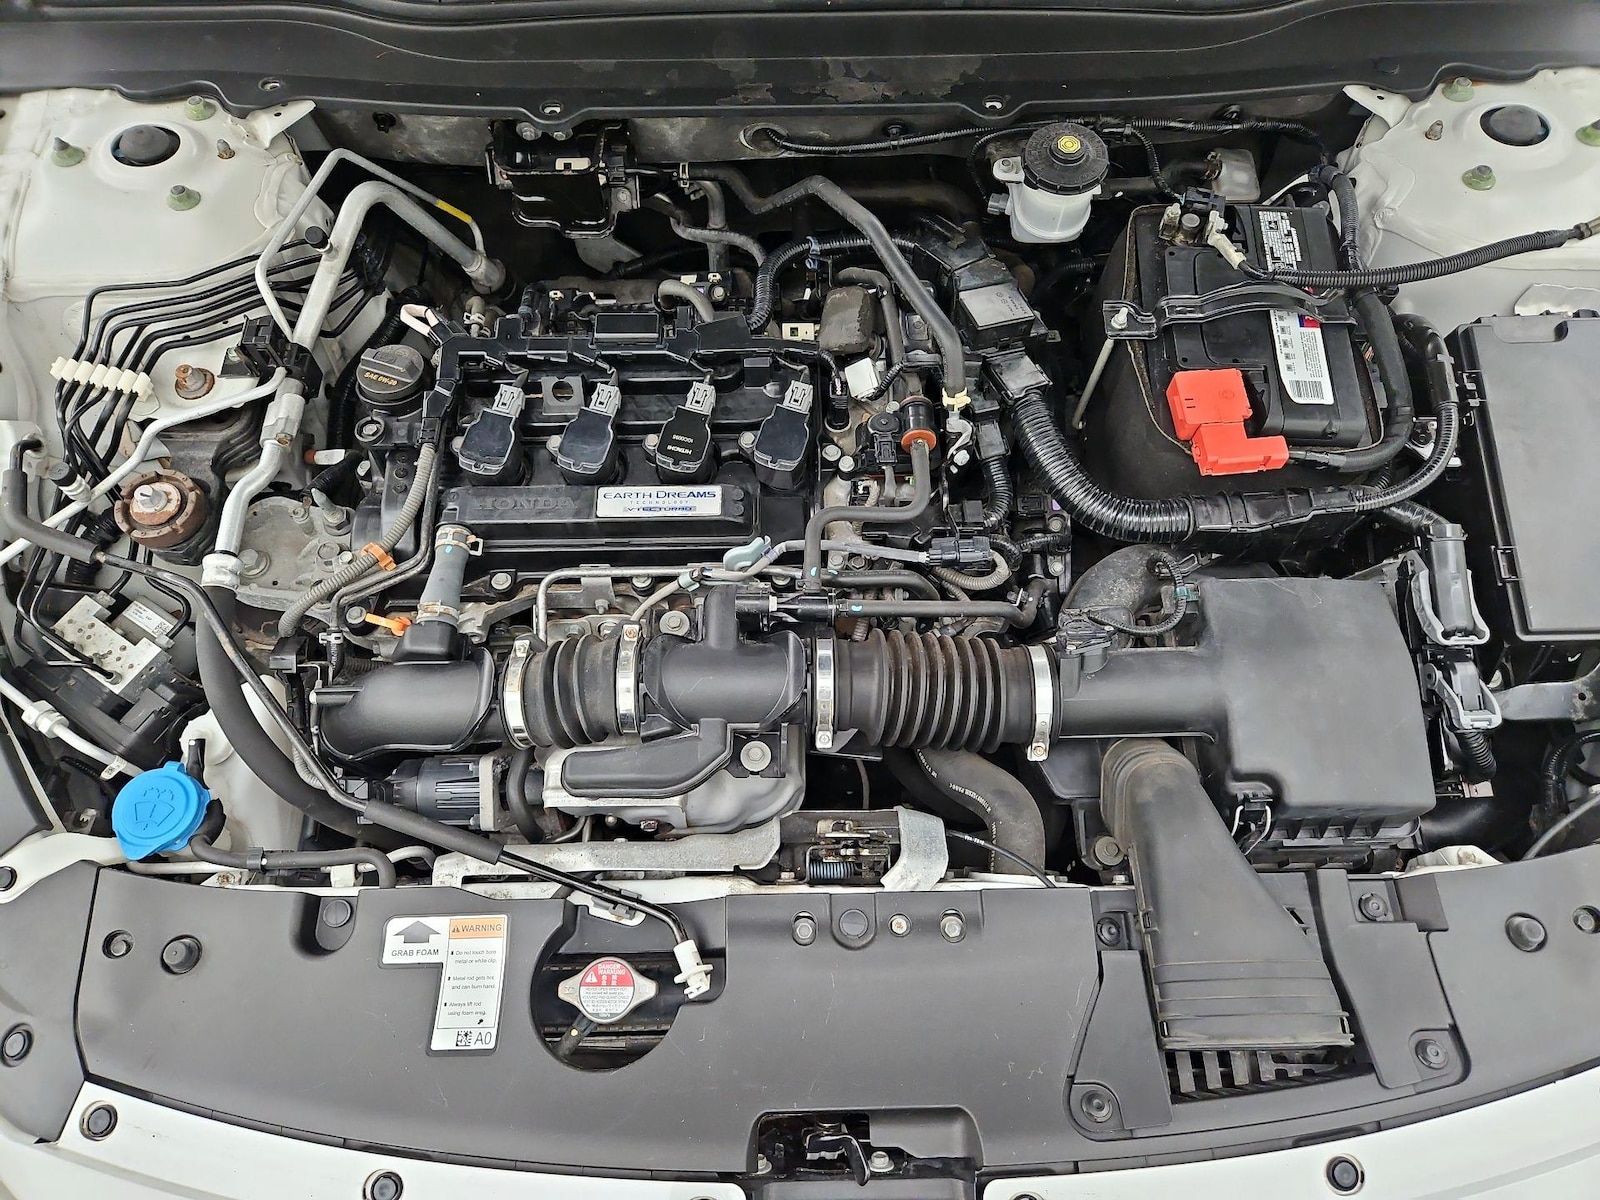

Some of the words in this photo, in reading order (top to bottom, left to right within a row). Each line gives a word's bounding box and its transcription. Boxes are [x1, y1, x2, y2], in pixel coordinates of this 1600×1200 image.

[364, 372, 378, 381] SAE
[378, 375, 398, 386] 0W-20
[603, 491, 652, 499] EARTH
[656, 490, 716, 498] DREAMS
[473, 495, 578, 511] HONDA
[461, 924, 502, 932] WARNING
[391, 949, 414, 957] GRAB
